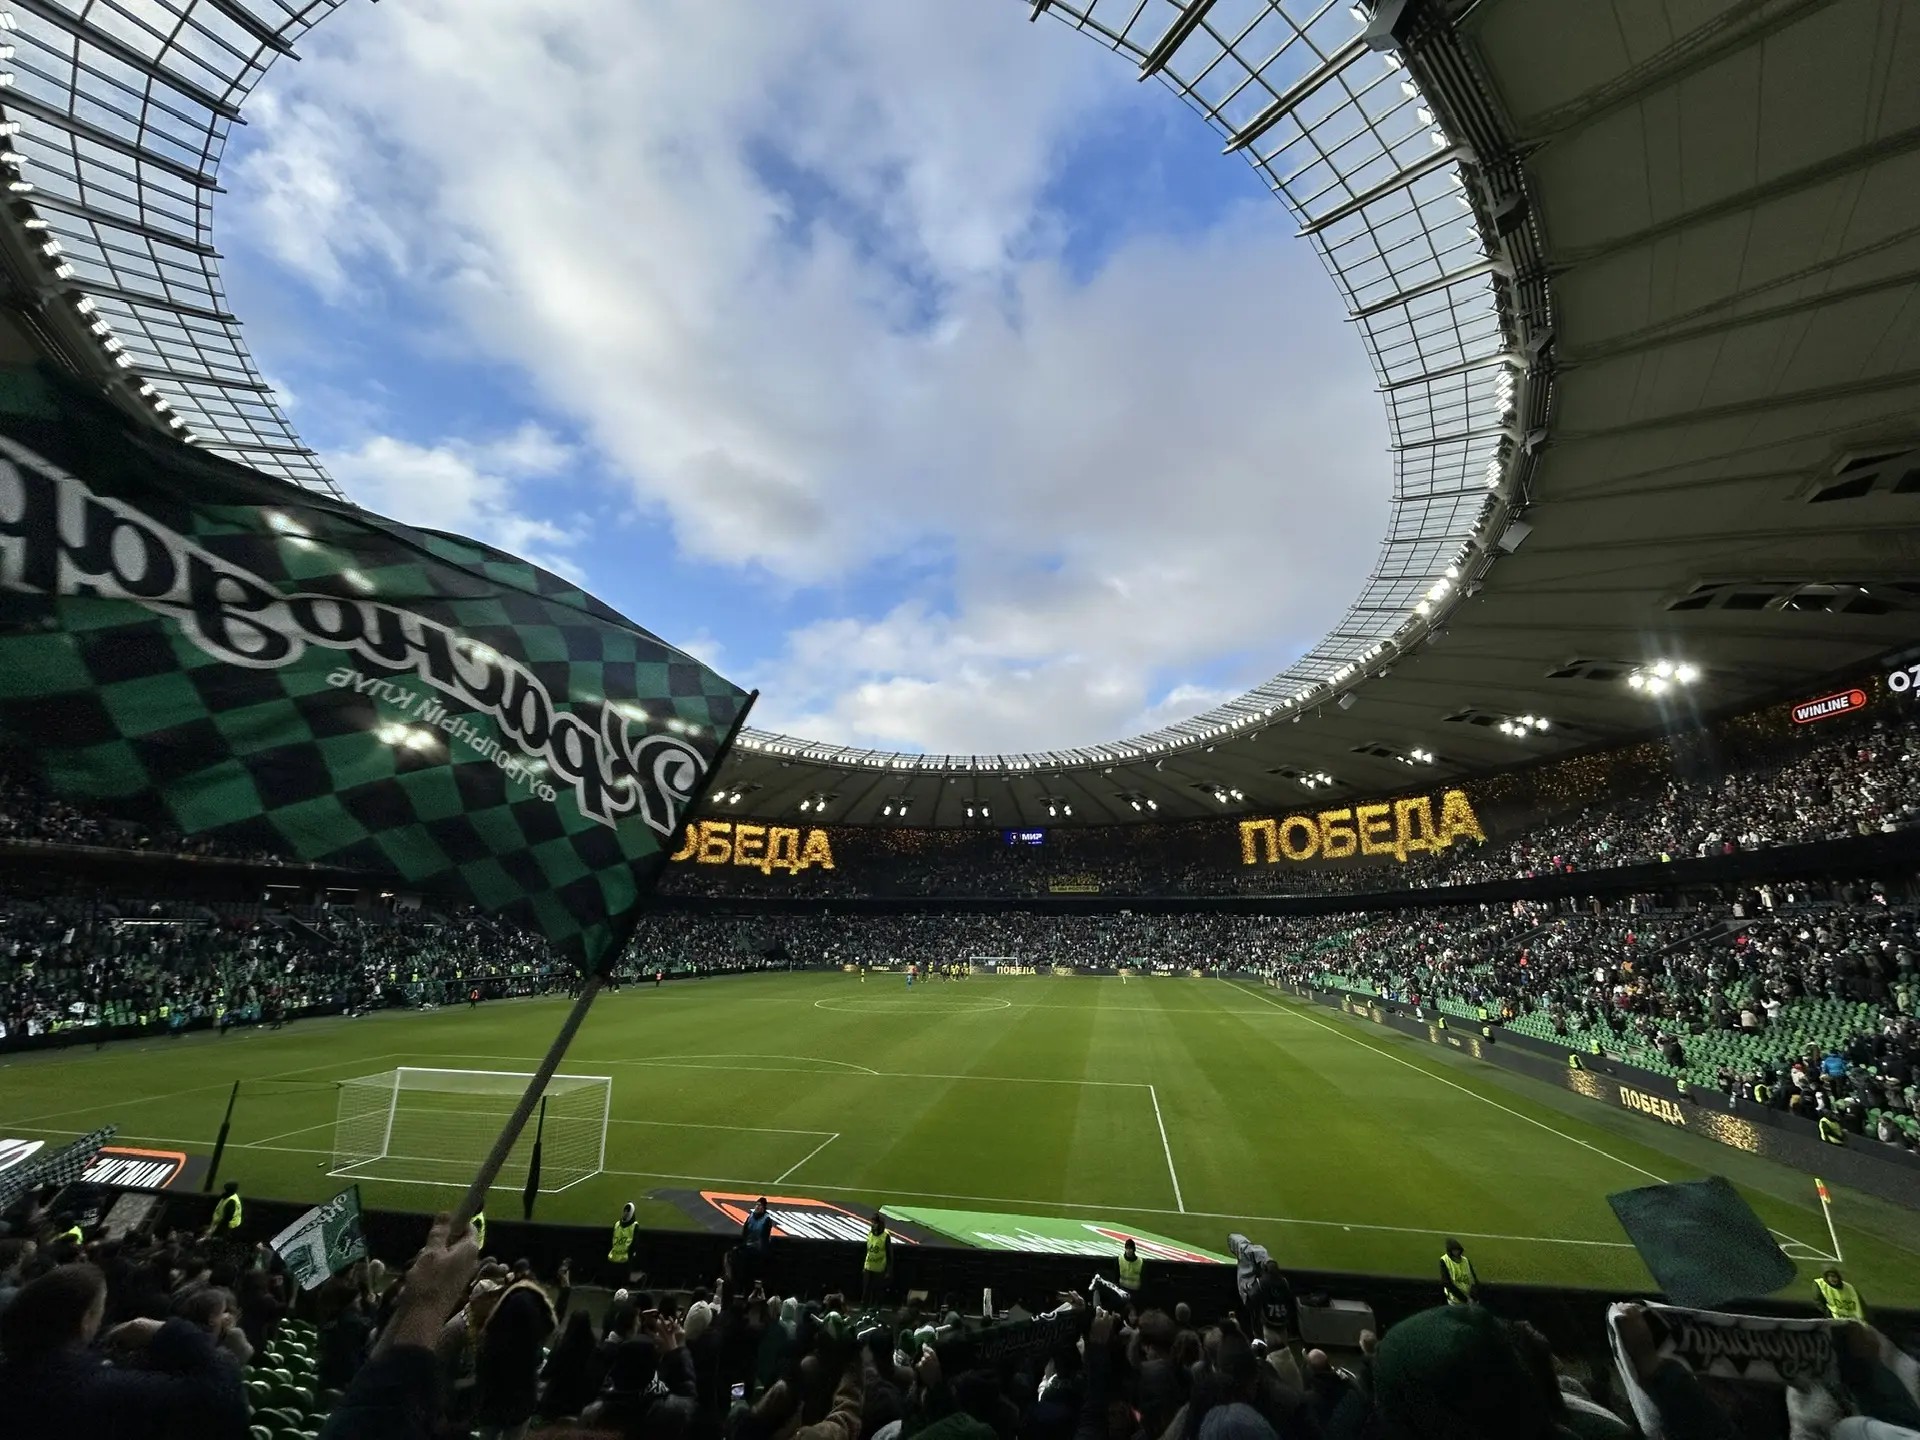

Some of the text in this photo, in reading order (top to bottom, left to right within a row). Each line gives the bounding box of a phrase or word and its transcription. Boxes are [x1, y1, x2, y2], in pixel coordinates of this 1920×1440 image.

[1796, 695, 1850, 720] WINLINE
[1240, 788, 1488, 864] ПОБЕДА
[1619, 1086, 1686, 1125] ПОБЕДА
